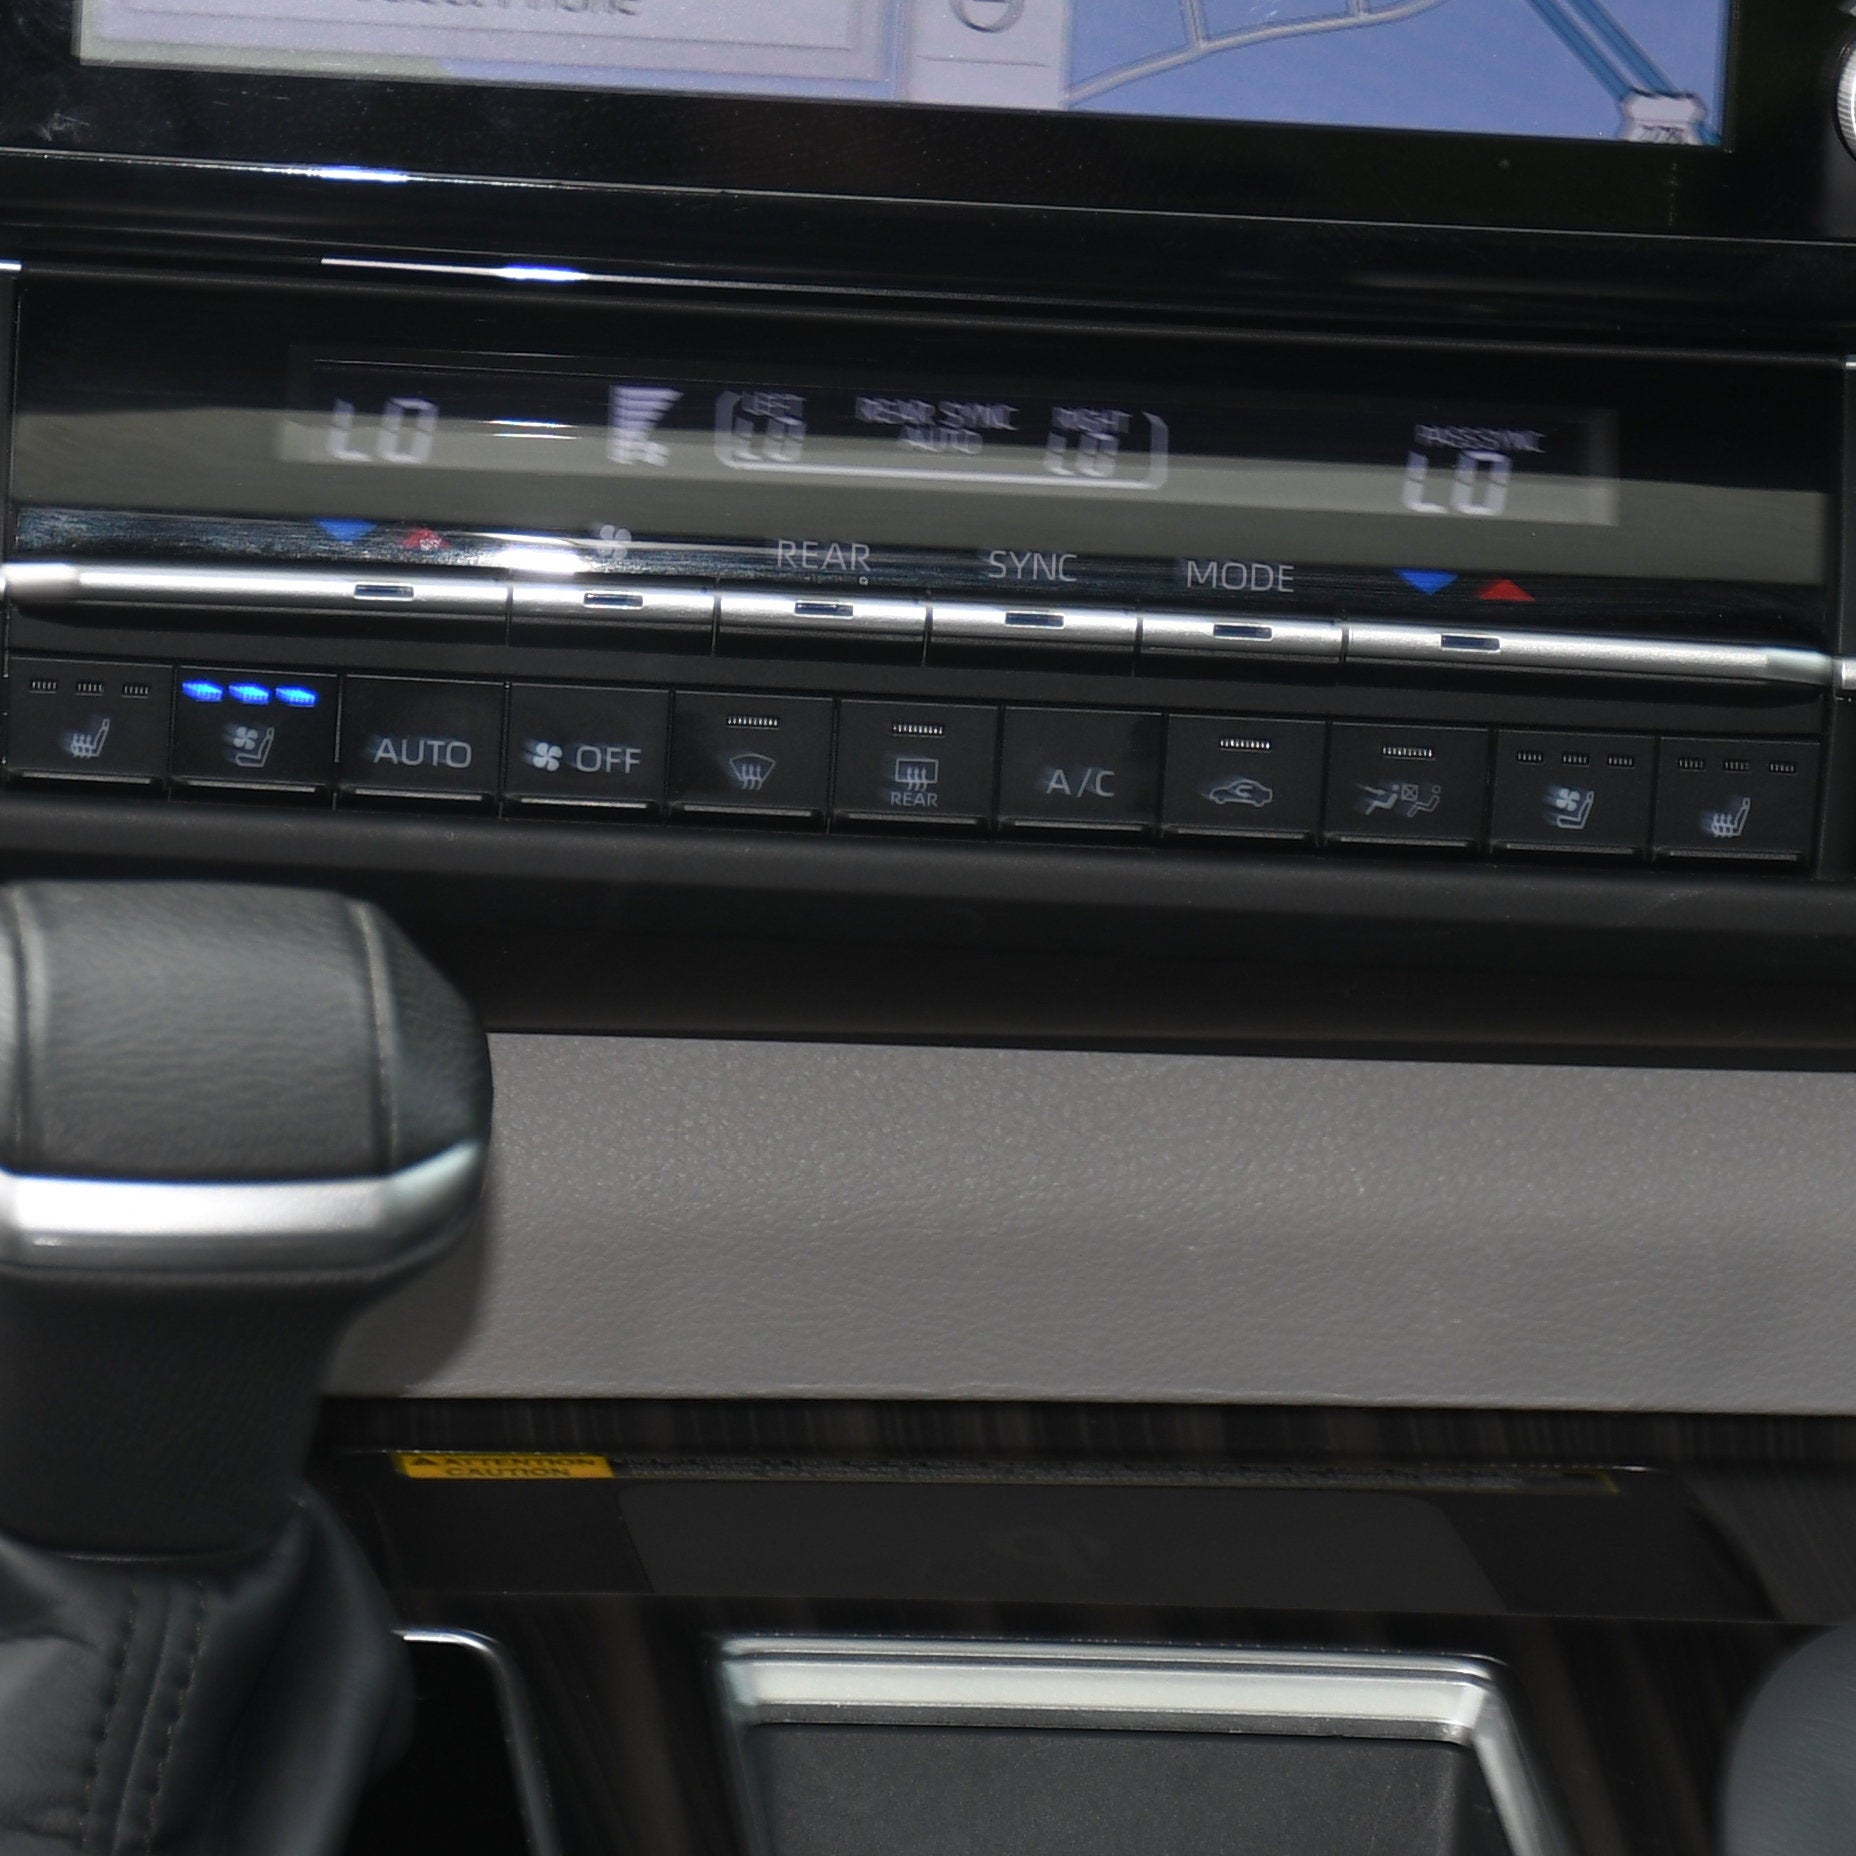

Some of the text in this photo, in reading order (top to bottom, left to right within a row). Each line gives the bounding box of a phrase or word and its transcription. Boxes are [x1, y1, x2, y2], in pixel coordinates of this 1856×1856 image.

[776, 538, 872, 573] REAR
[987, 549, 1078, 583] SYNC
[1186, 559, 1296, 594] MODE
[373, 736, 472, 771] AUTO
[575, 744, 642, 776] OFF
[890, 791, 939, 808] REAR
[1046, 766, 1116, 800] A/C
[445, 1456, 596, 1468] ATTENTION
[446, 1466, 570, 1478] CAUTION
